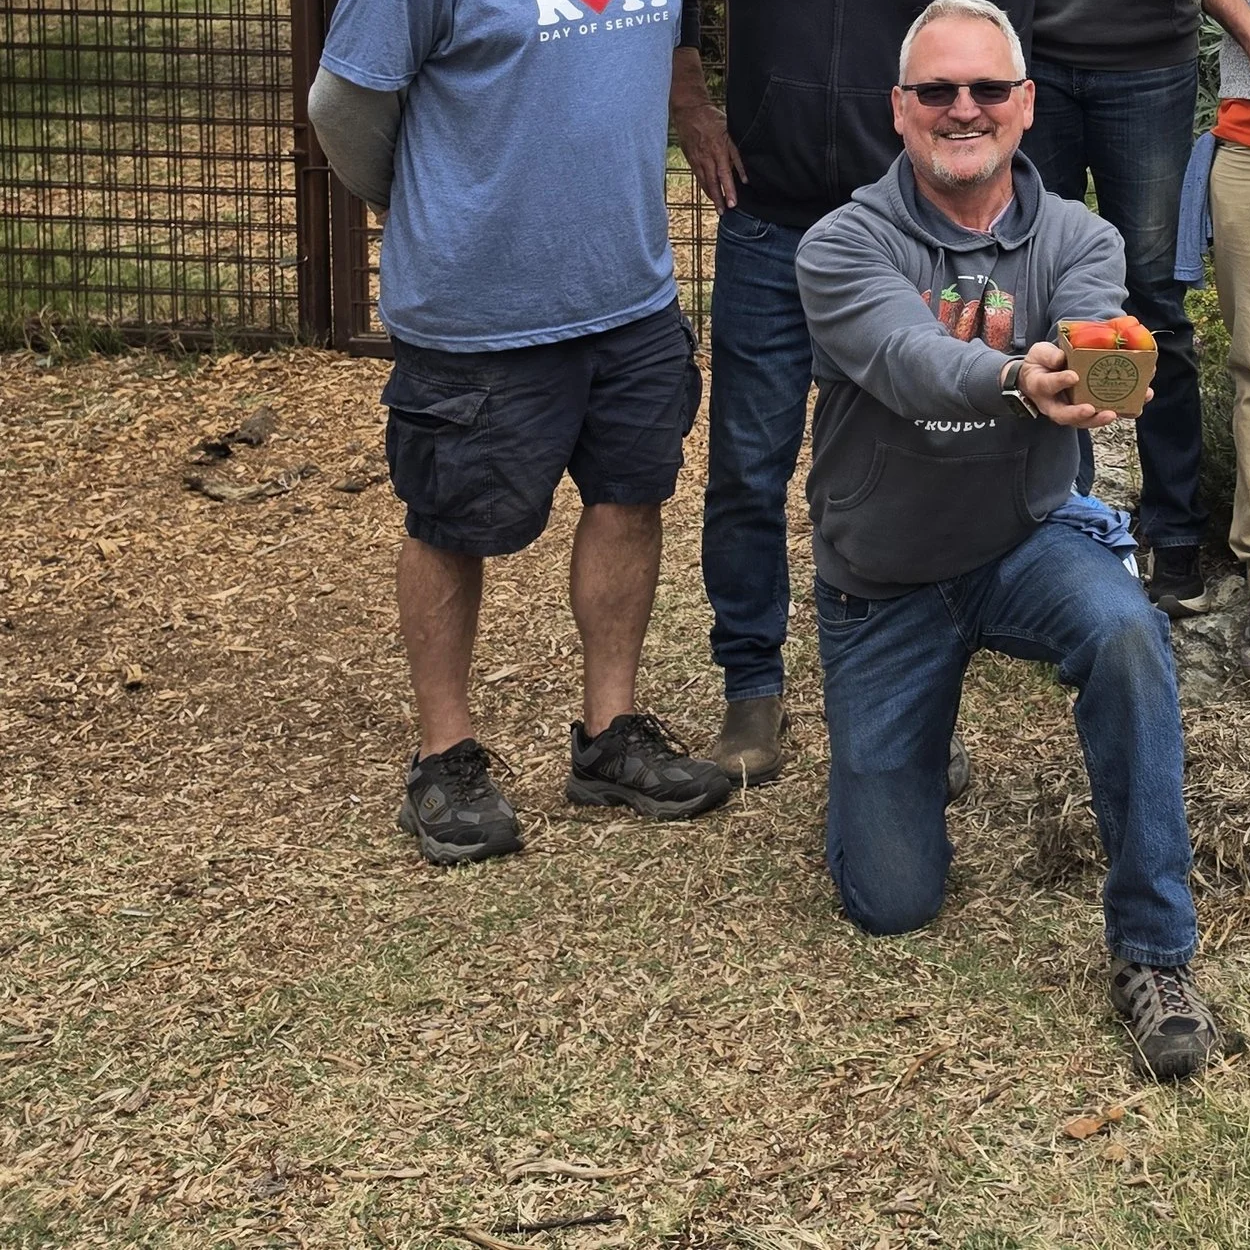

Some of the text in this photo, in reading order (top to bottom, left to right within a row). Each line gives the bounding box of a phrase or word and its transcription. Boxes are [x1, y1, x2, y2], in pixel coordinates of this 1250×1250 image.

[539, 10, 669, 42] DAY OF SERVICE
